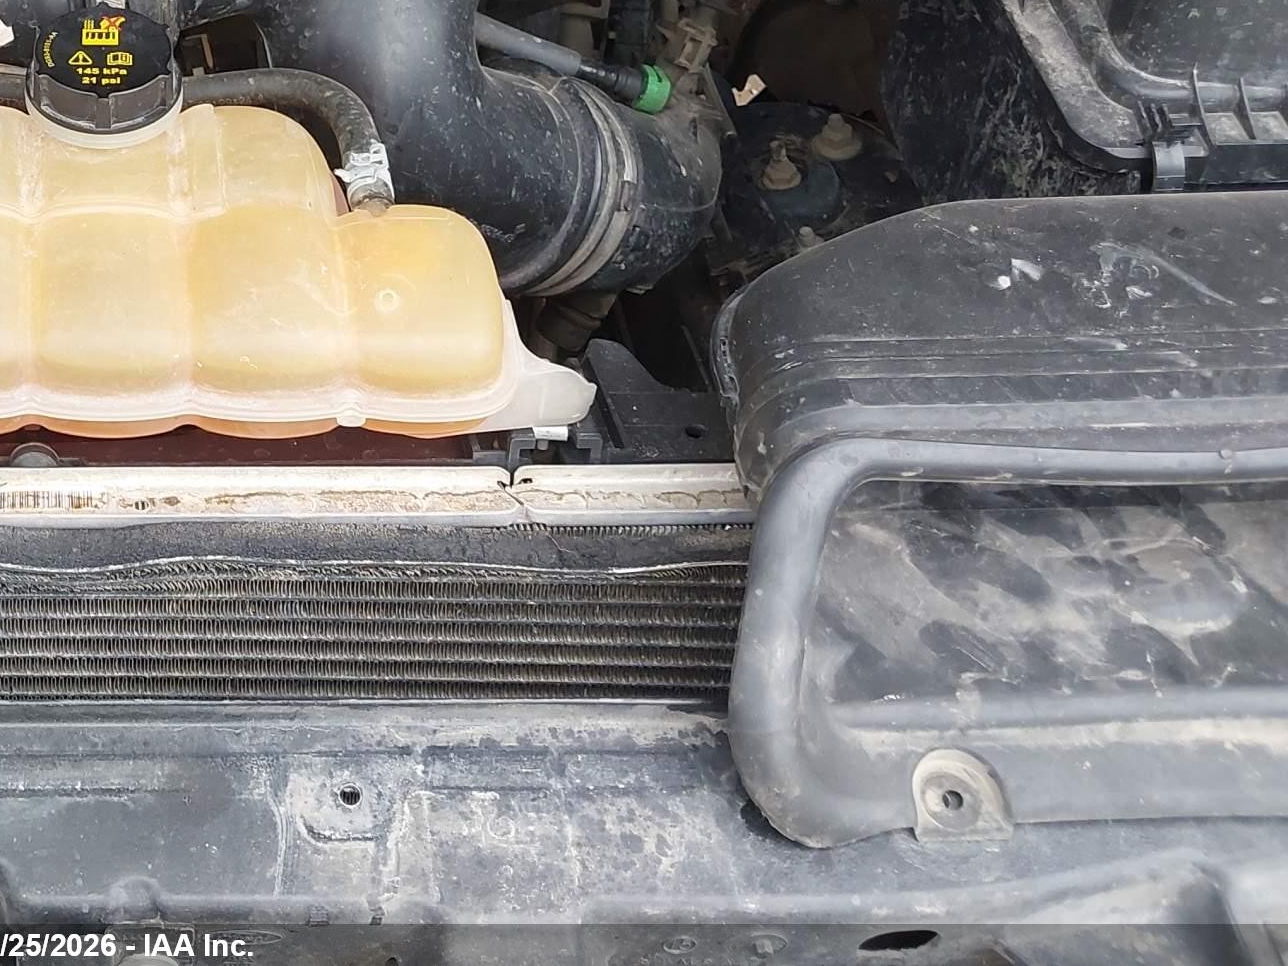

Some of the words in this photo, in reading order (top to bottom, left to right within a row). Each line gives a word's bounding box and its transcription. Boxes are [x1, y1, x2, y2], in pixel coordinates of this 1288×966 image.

[75, 67, 100, 75] 145
[102, 67, 128, 75] kPa
[81, 76, 97, 85] 21
[101, 76, 121, 86] psi
